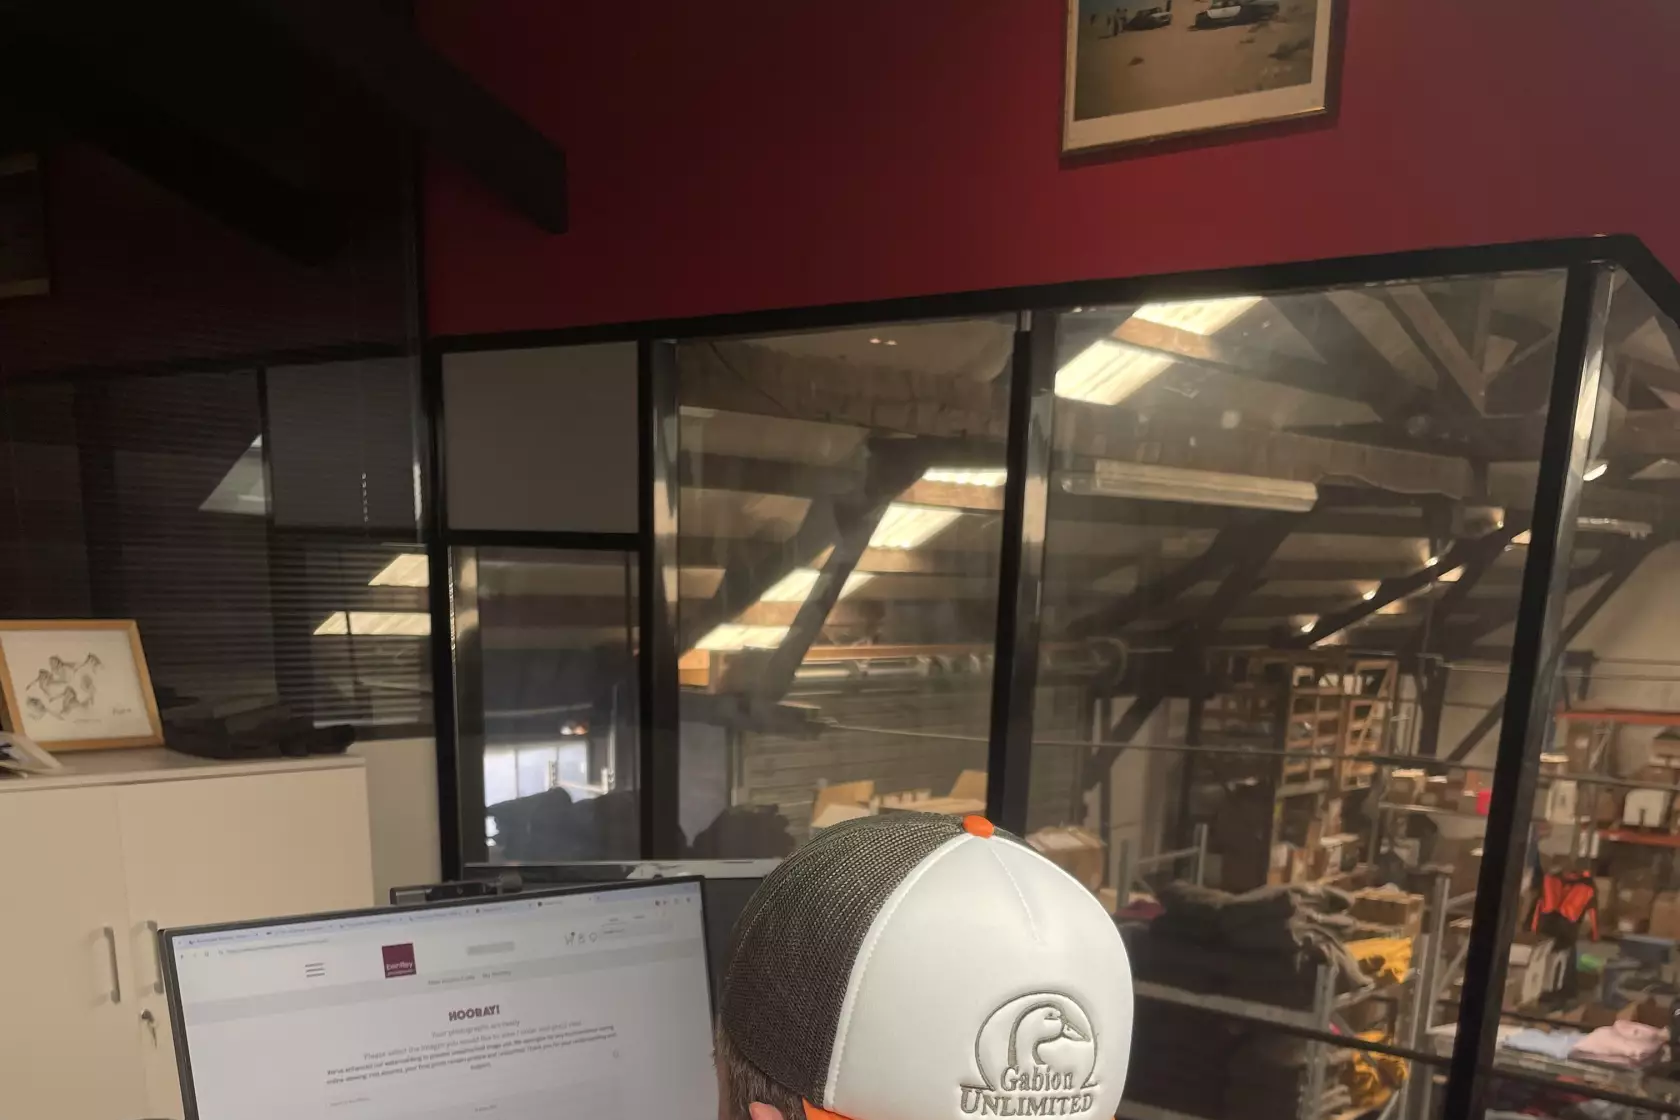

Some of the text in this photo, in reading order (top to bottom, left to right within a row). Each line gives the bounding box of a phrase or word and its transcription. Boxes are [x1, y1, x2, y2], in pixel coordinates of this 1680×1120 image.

[448, 1004, 500, 1021] HOORAY!
[1000, 1066, 1073, 1091] Gabion
[960, 1089, 1093, 1116] UNLIMITED
